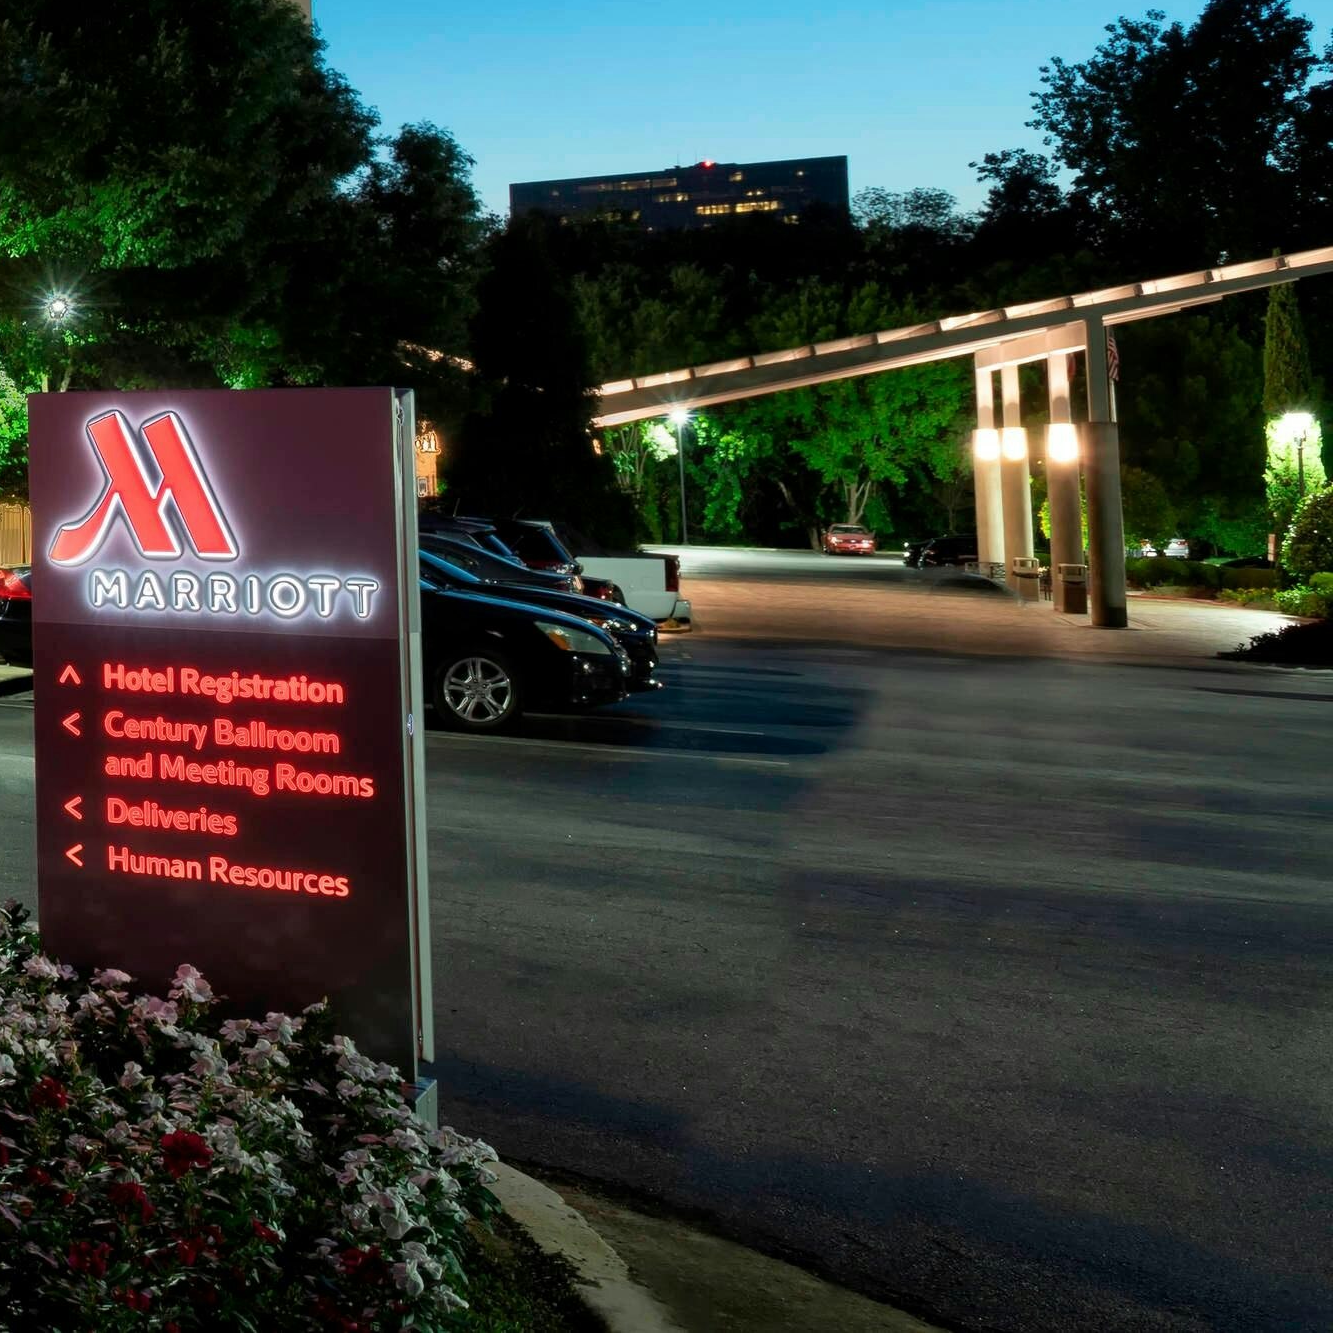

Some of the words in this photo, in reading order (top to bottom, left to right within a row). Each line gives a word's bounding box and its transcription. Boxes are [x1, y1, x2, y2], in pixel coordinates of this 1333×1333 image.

[90, 569, 379, 618] MARRIOTT
[102, 663, 175, 694] Hotel
[179, 667, 345, 704] Registration
[103, 709, 208, 751] Century
[213, 717, 341, 754] Ballroom
[104, 752, 153, 780] and
[159, 755, 270, 795] Meeting
[275, 763, 375, 798] Rooms
[106, 796, 239, 836] Deliveries
[107, 845, 204, 880] Human
[209, 855, 351, 898] Resources
